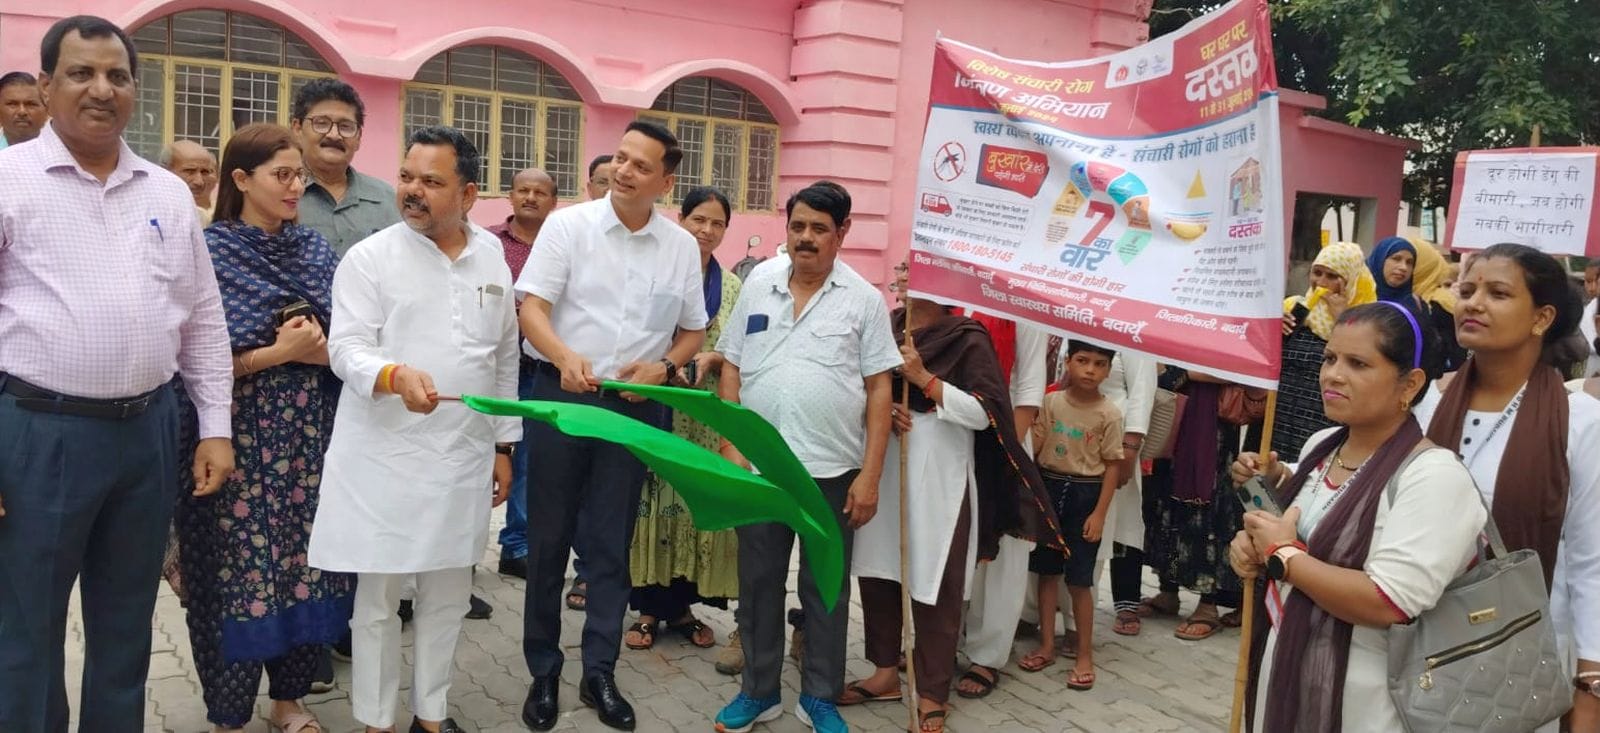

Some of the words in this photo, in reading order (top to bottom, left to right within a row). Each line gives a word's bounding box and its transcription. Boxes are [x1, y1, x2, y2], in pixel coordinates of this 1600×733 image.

[966, 58, 1010, 80] विशेष
[1012, 73, 1064, 93] संचारी
[1065, 79, 1095, 95] रोग
[1012, 92, 1112, 119] अभियान
[1132, 143, 1175, 163] संचारी
[1178, 136, 1204, 159] रोगों
[1205, 132, 1220, 152] को
[1488, 168, 1504, 185] दूर
[1508, 164, 1537, 183] होगी
[1563, 165, 1581, 182] की
[1555, 192, 1585, 211] होगी
[1084, 200, 1115, 247] 7
[1229, 220, 1264, 239] दस्तक
[1514, 218, 1575, 237] भागीदारी
[1093, 236, 1114, 250] का
[1060, 242, 1112, 271] वार
